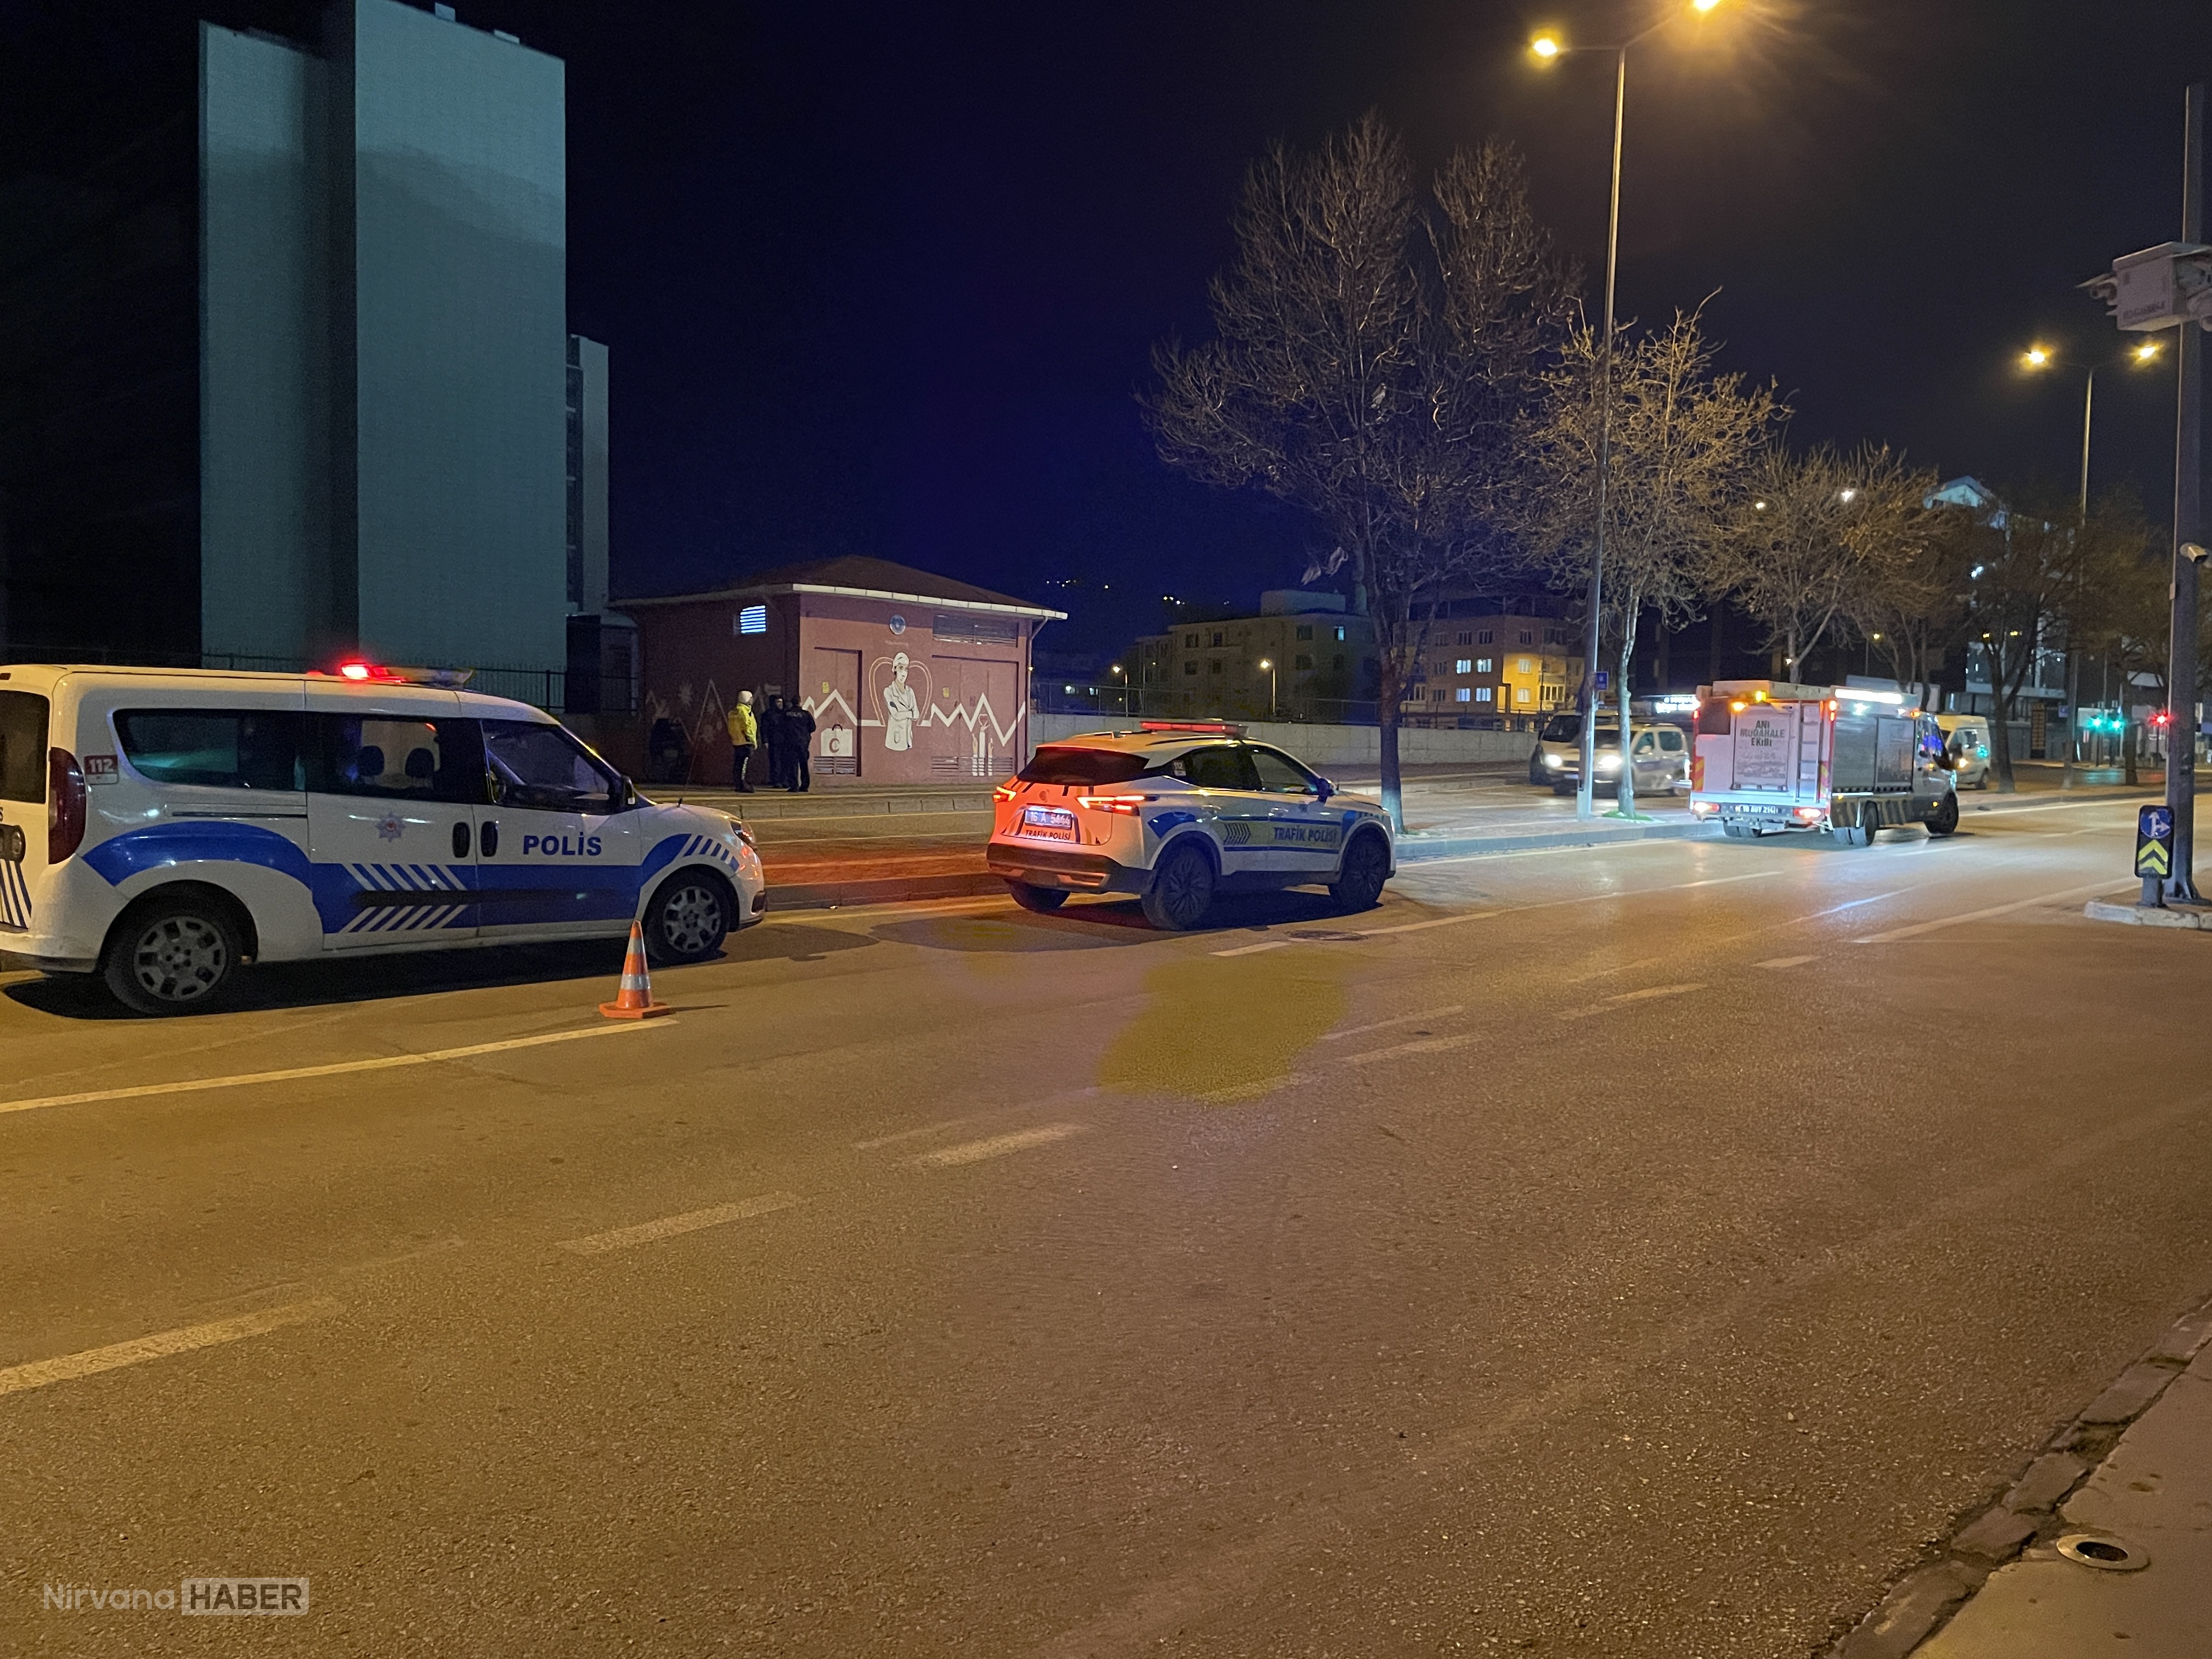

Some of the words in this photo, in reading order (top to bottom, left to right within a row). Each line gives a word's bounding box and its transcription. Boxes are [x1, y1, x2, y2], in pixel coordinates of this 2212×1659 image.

[89, 759, 114, 773] 112
[1030, 811, 1038, 822] 16
[1040, 812, 1046, 822] A
[523, 832, 601, 856] POLİS
